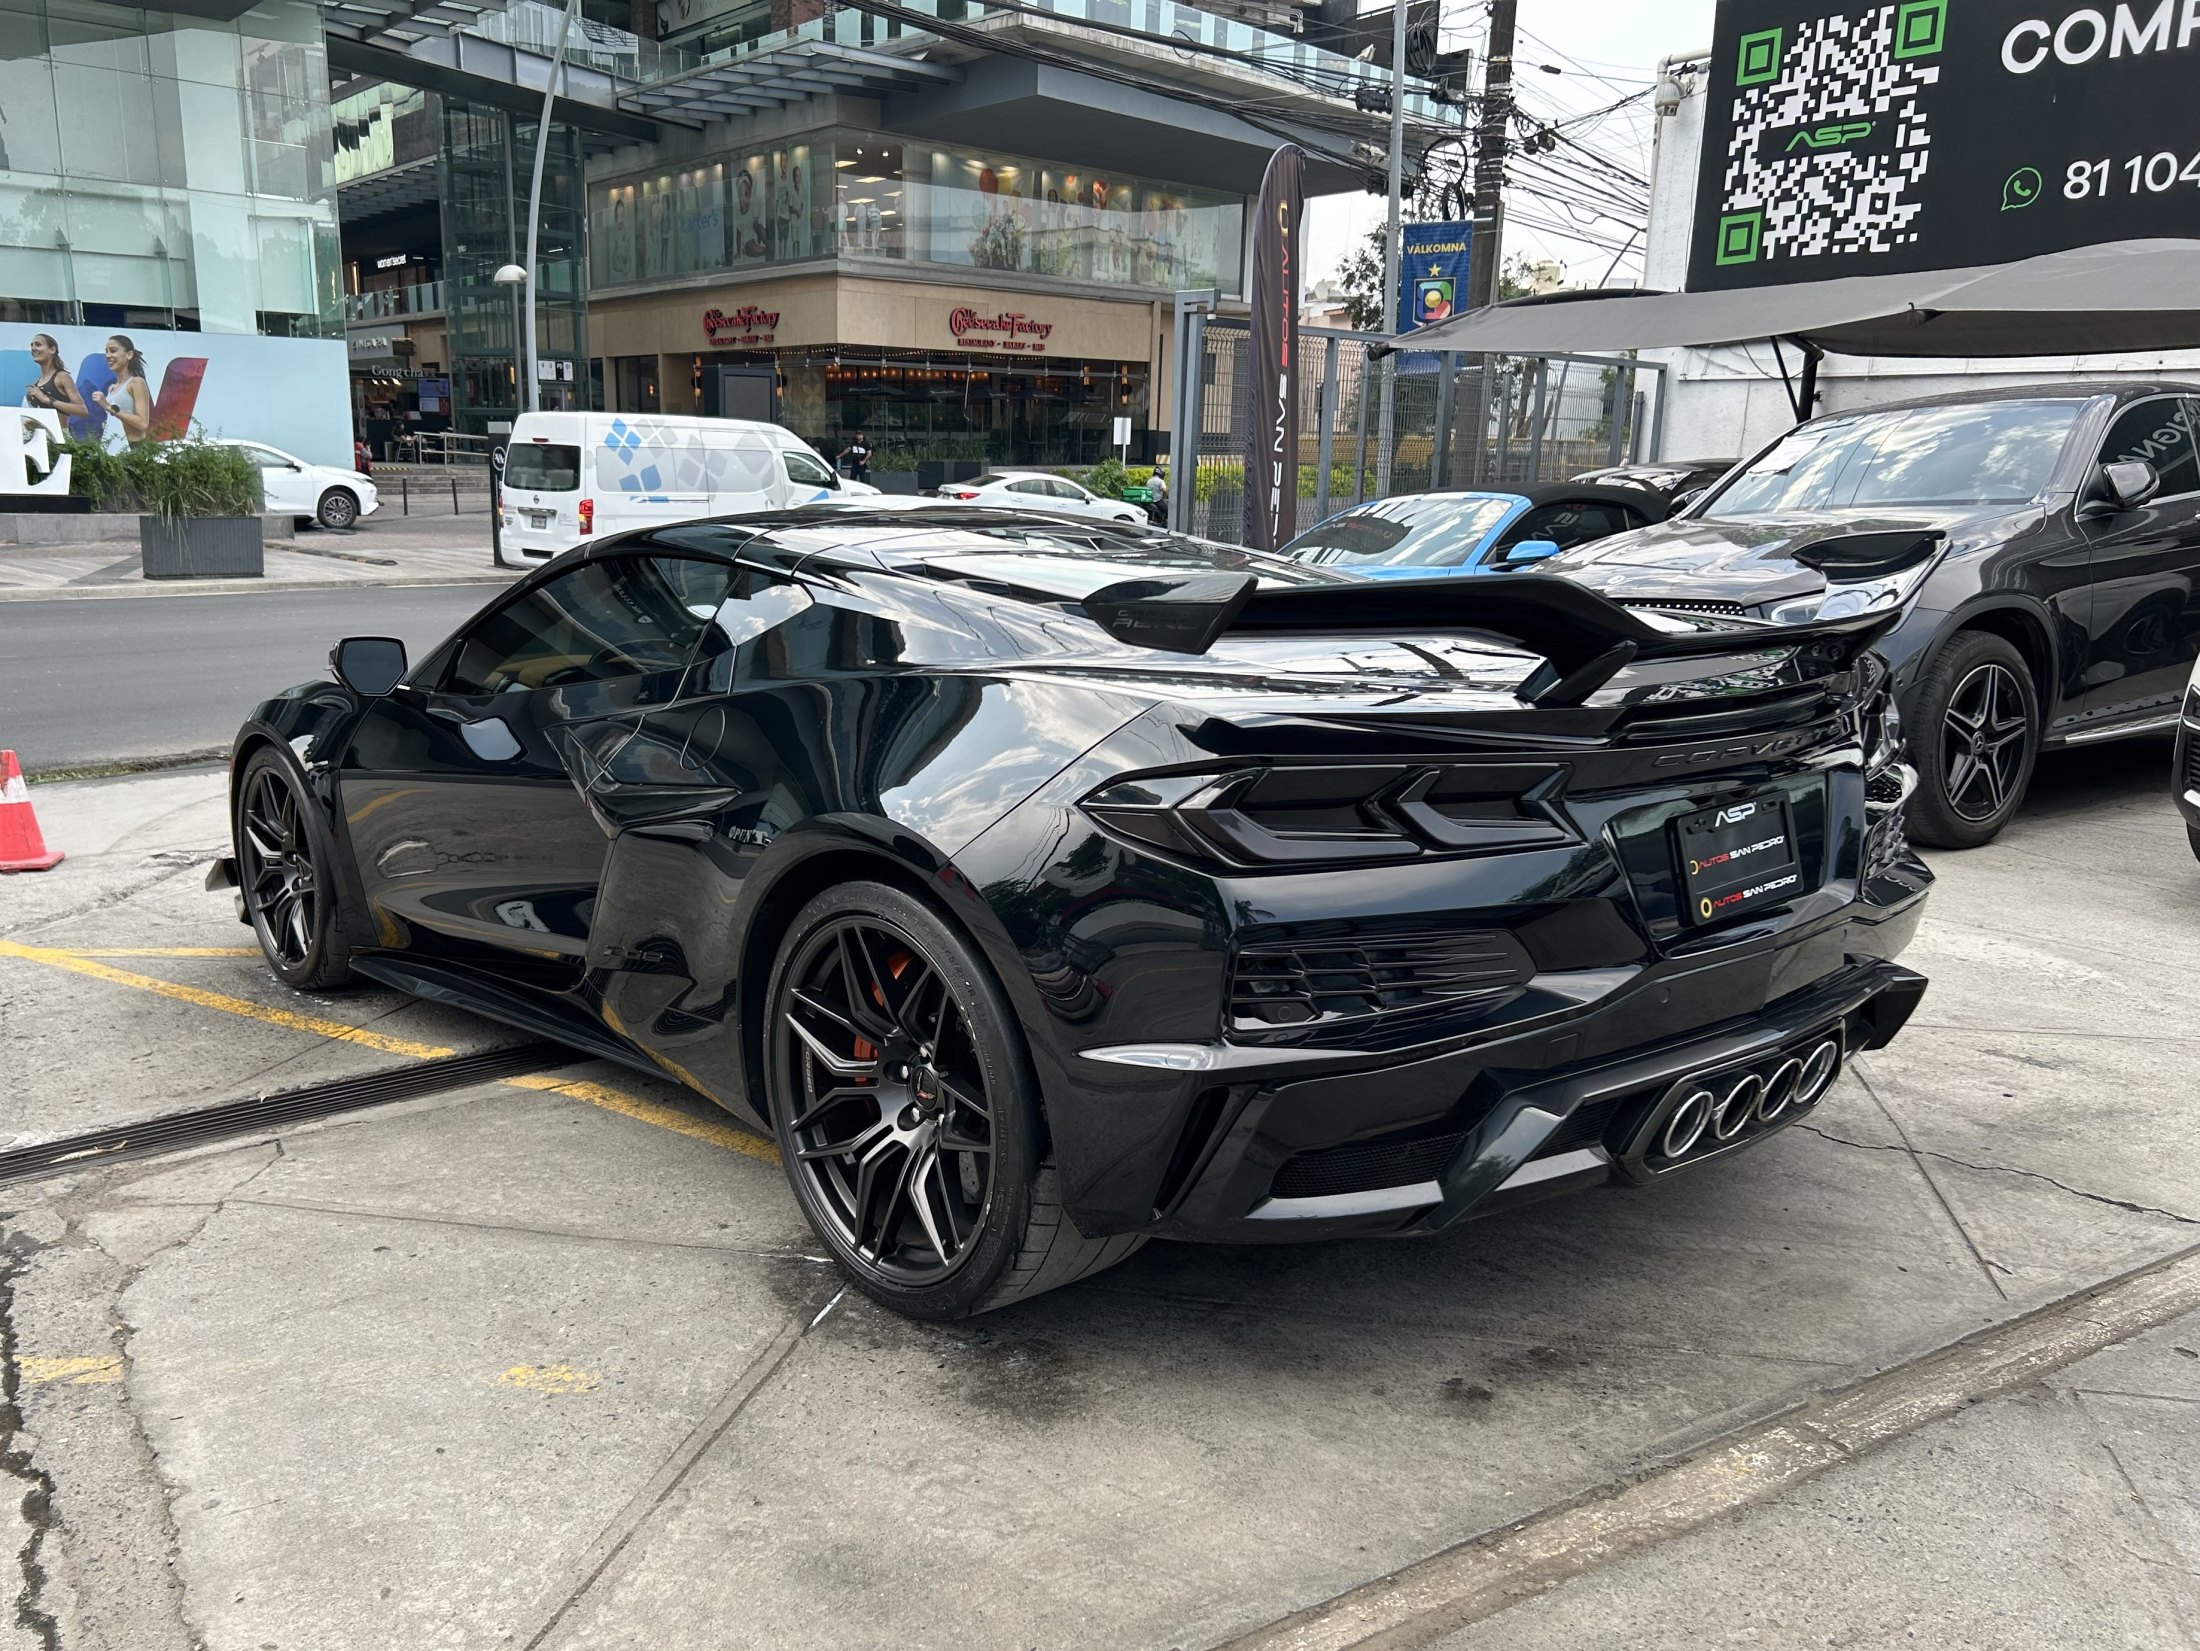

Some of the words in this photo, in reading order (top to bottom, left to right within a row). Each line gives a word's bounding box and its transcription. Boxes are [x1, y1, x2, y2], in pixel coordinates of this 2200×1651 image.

[2063, 158, 2110, 200] 81
[1407, 242, 1467, 255] VÄLKOMNA
[1281, 243, 1290, 368] AUTOS
[949, 307, 1010, 337] Cheesecake
[1005, 312, 1053, 340] Factory
[371, 364, 402, 378] Gong
[1273, 373, 1288, 453] SAN
[1698, 853, 1730, 870] AUTOS
[1729, 845, 1752, 860] SAN
[1751, 835, 1784, 853] PEDRO
[1713, 892, 1743, 909] AUTOS
[1742, 884, 1764, 899] SAN
[1763, 874, 1797, 892] PEDRO
